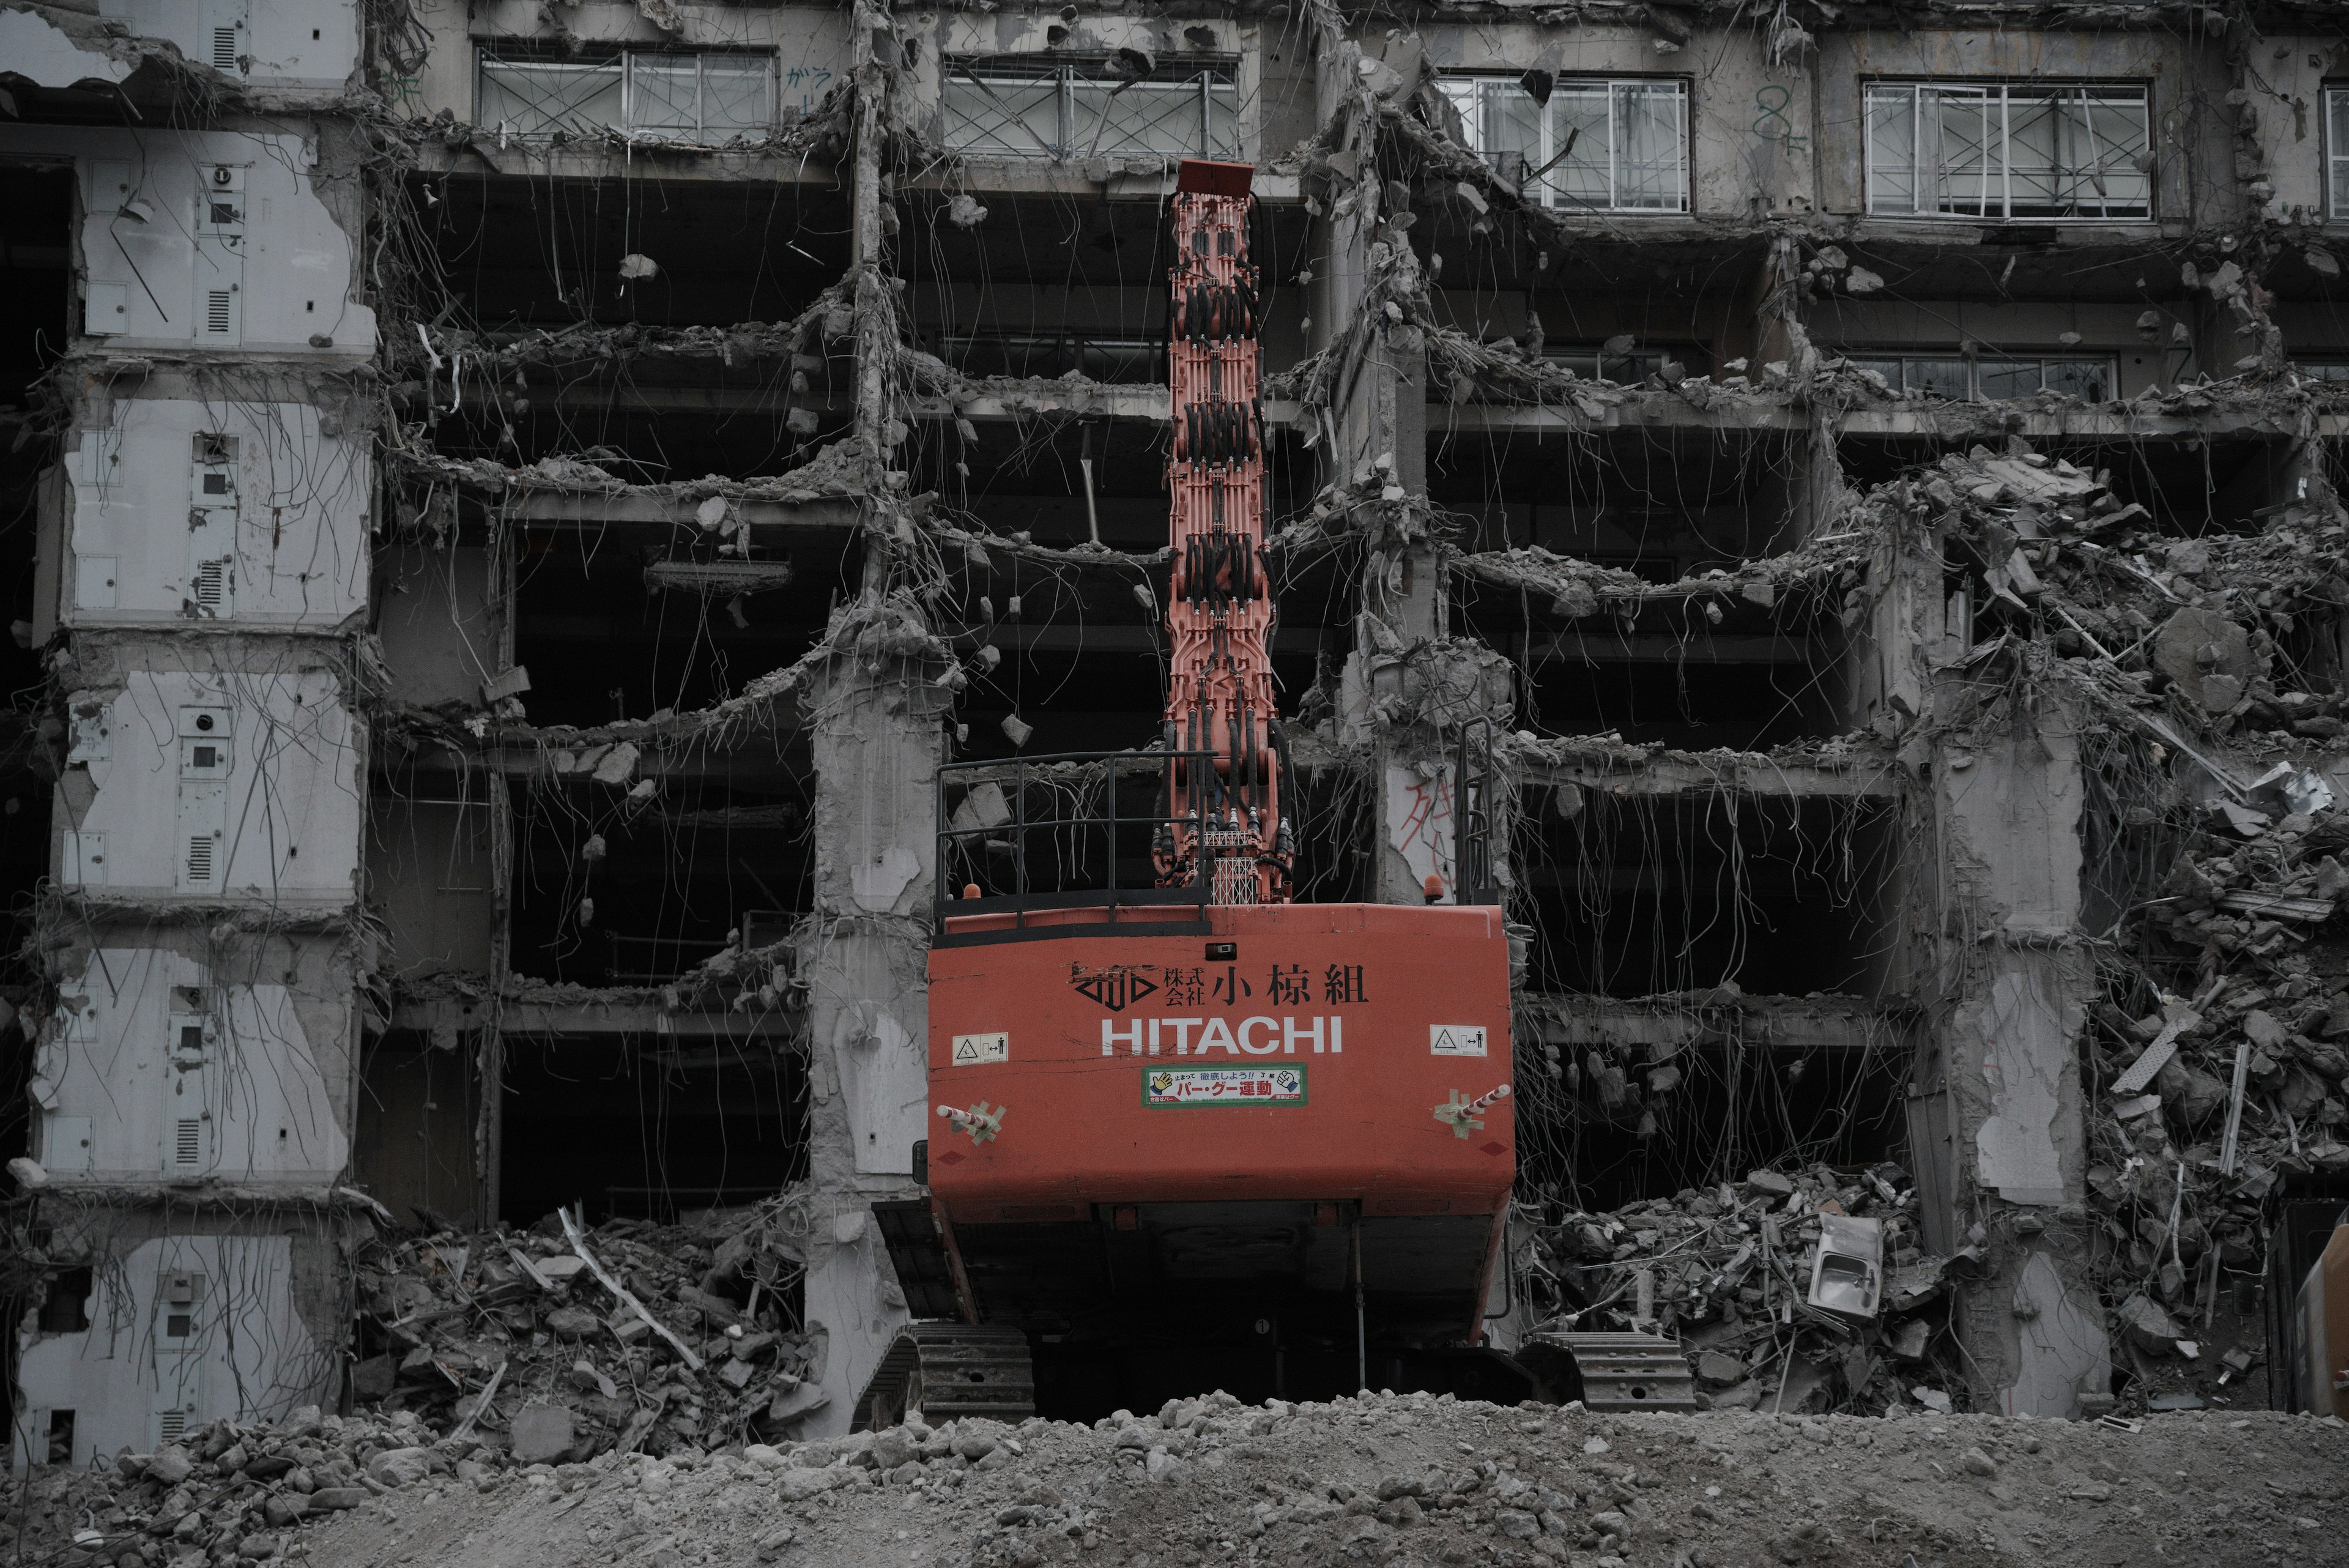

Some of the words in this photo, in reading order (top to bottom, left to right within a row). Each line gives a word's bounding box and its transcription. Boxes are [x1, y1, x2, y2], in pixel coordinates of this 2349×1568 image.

[1753, 84, 1808, 156] 8F
[1163, 967, 1205, 987] 株式
[1212, 964, 1370, 1006] 小椋組
[1164, 987, 1206, 1007] 会社
[1102, 1016, 1342, 1056] HITACHI
[1200, 1072, 1255, 1080] 徹底しよう!!
[1177, 1080, 1272, 1097] パー・グー運動
